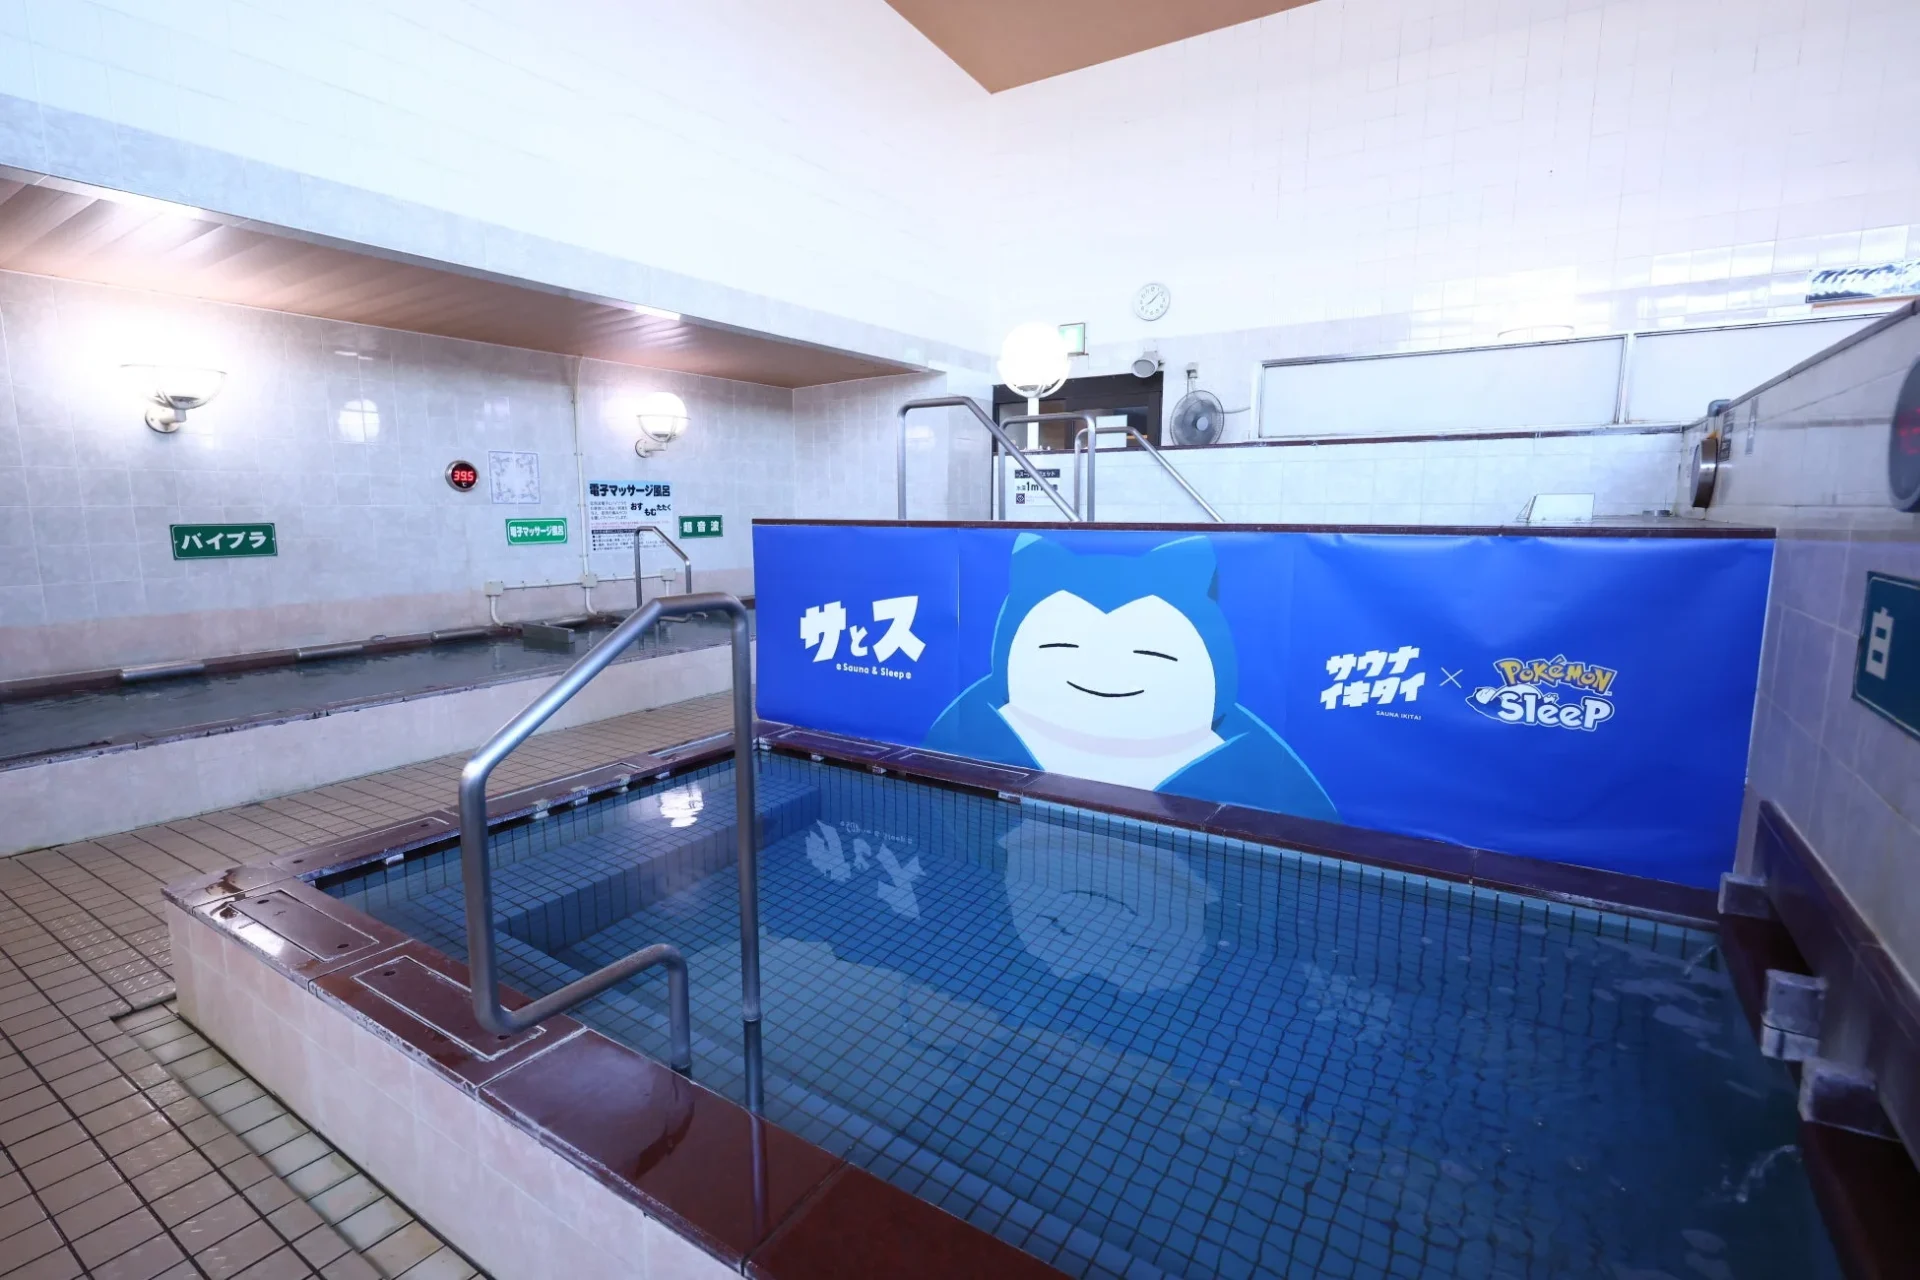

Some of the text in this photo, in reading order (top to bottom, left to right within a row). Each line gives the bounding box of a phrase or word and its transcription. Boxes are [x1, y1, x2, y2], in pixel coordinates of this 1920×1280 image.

[589, 483, 671, 497] 電子マッサージ風呂
[509, 525, 564, 538] 電子マッサージ風呂
[683, 520, 720, 533] 超音波
[181, 531, 267, 550] バイブラ
[800, 595, 927, 663] サとス
[843, 663, 905, 680] Sauna & Sleep
[1326, 645, 1420, 681] サウナ
[1320, 672, 1426, 710] イキタイ
[1376, 710, 1399, 718] SAUNA
